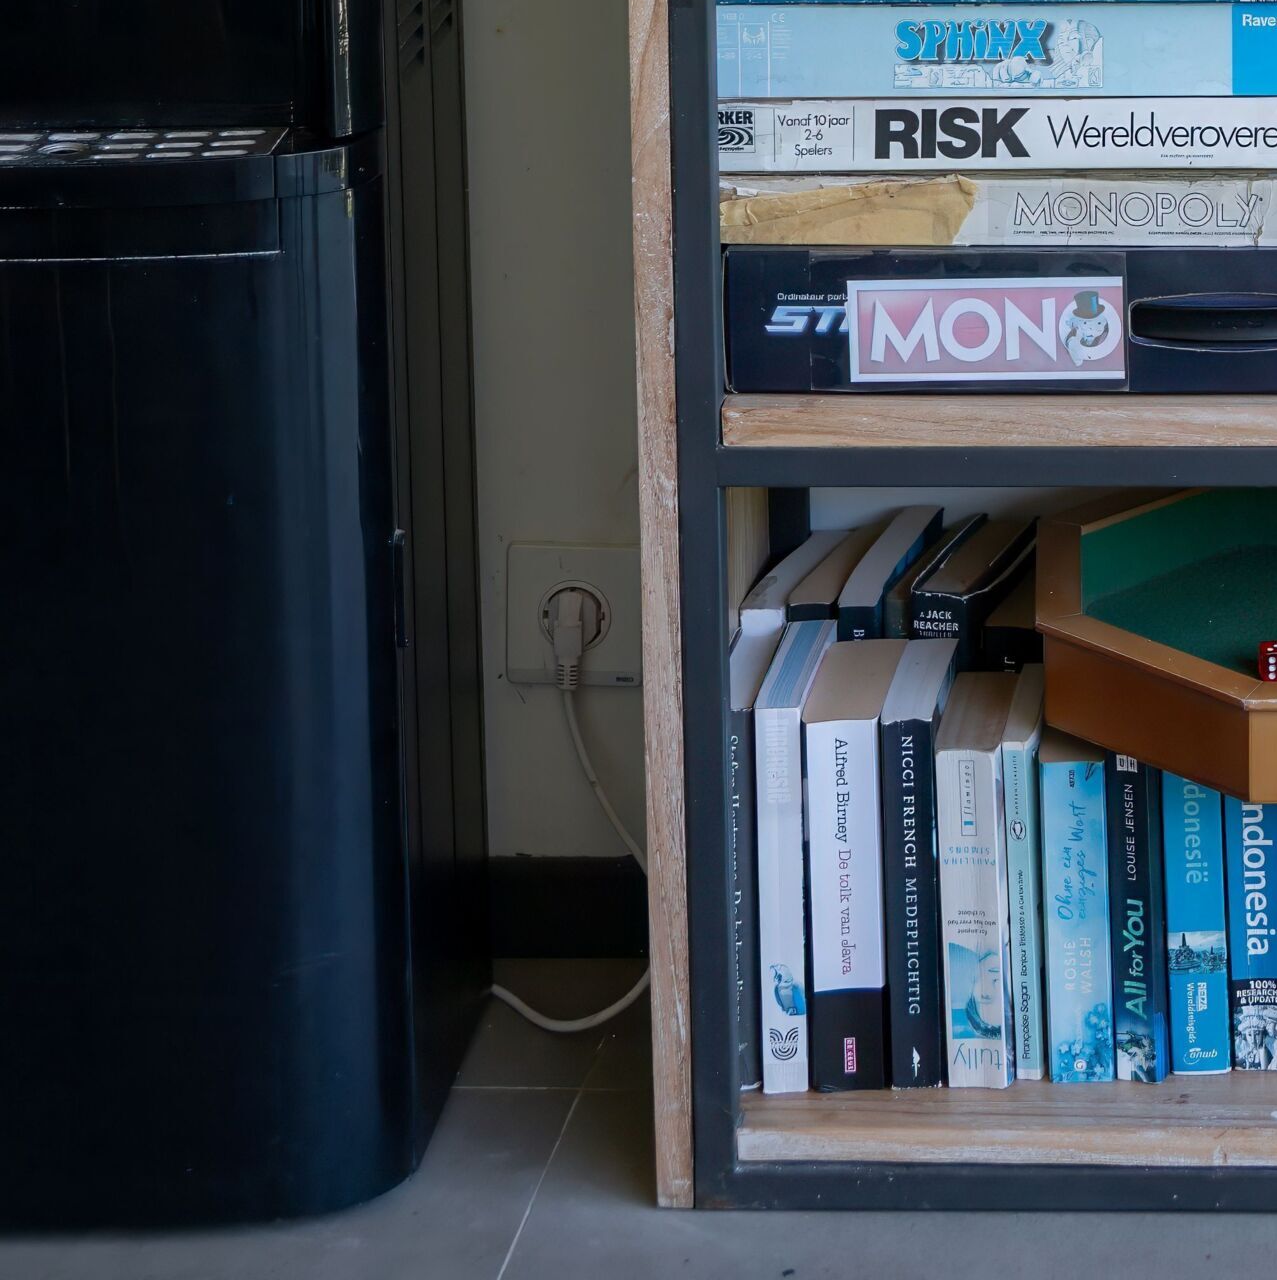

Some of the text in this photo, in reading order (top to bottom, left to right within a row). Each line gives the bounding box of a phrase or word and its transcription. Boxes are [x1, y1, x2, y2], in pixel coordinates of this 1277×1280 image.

[777, 113, 851, 129] Vanaf 10 jaar
[804, 128, 824, 141] 2-6
[874, 106, 1031, 160] RISK
[794, 143, 833, 158] Spelers
[1013, 190, 1259, 229] MONOPOLY
[777, 292, 825, 301] Ordinateur
[870, 291, 1122, 364] MONO
[913, 620, 960, 632] REACHER
[926, 610, 952, 620] JACK
[1123, 782, 1138, 882] LOUISE JENSEN
[1182, 778, 1209, 886] donesië
[835, 737, 857, 976] Alfred Birney De tolk van Java
[901, 734, 922, 1016] NICCI FRENCH MEDEPLICHTIG
[1057, 874, 1075, 922] Ohne
[1064, 939, 1077, 993] ROSIE
[1080, 936, 1093, 995] WALSH
[1121, 898, 1148, 1020] All for You
[1020, 980, 1031, 1009] Sagan
[1249, 980, 1277, 990] 100%
[953, 1043, 1004, 1072] tully
